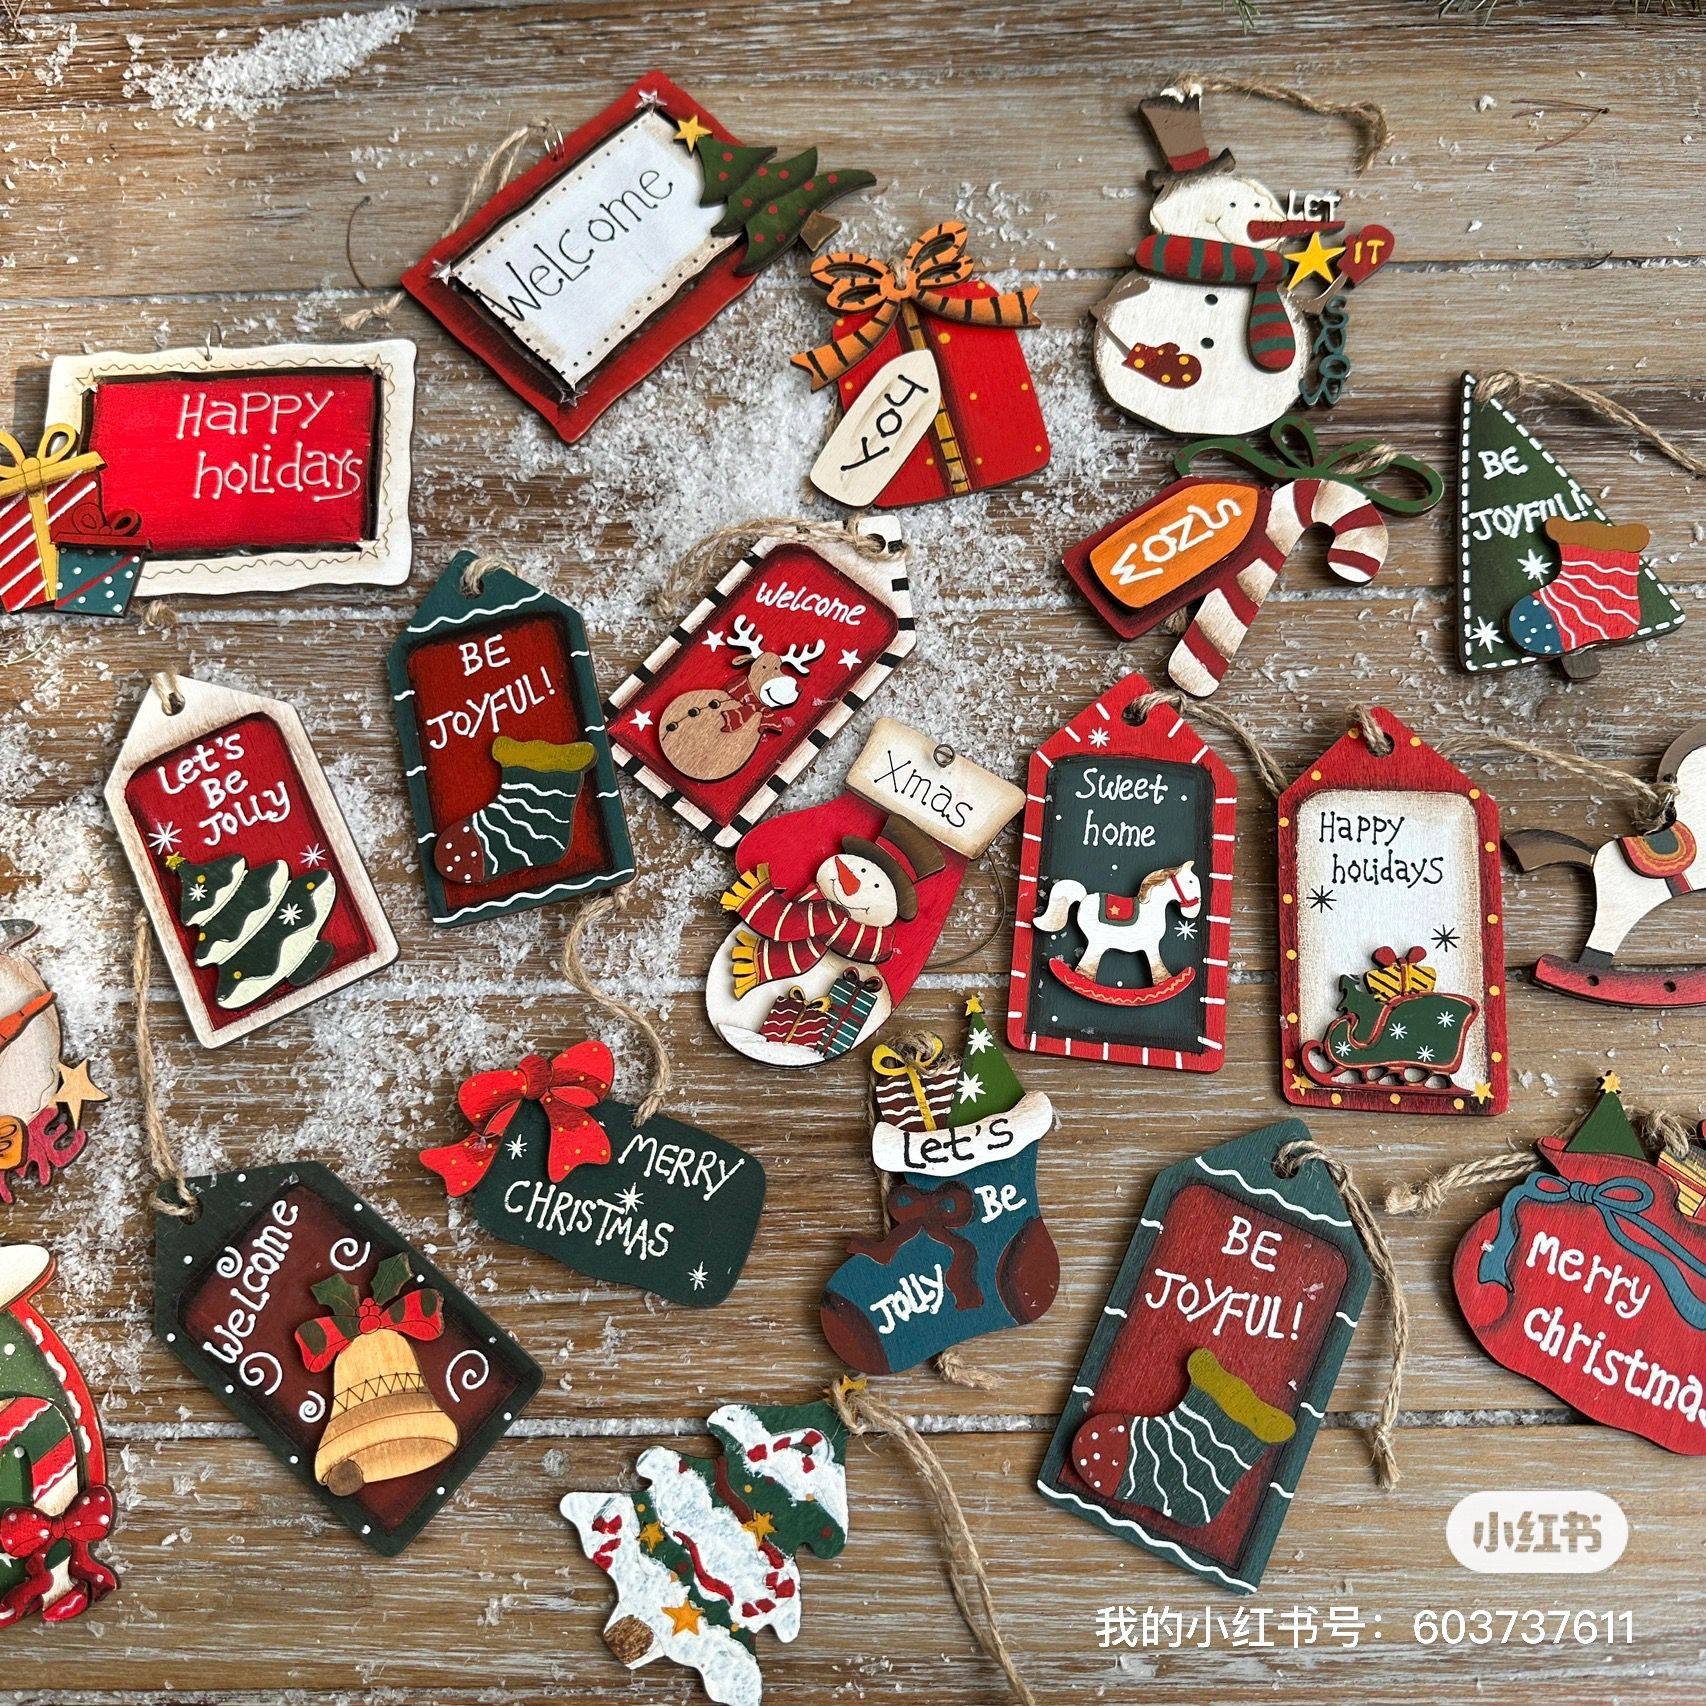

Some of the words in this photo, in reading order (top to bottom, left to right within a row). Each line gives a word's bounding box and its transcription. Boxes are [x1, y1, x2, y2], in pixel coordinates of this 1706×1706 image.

[1287, 189, 1341, 222] LET
[1354, 239, 1385, 265] IT
[1478, 446, 1529, 480] BE
[460, 635, 509, 676] BE
[426, 667, 556, 749] JOYFUL!
[157, 733, 245, 794] Let's
[206, 775, 248, 809] Be
[874, 750, 973, 828] Xmas
[1076, 768, 1168, 804] Sweet
[1083, 809, 1156, 847] home
[1332, 849, 1445, 888] holidays
[902, 1117, 1014, 1169] Let's
[618, 1133, 745, 1202] MERRY
[504, 1182, 675, 1261] CHRISTMAS
[975, 1183, 1027, 1224] Be
[1221, 1215, 1282, 1272] BE
[1145, 1268, 1303, 1340] JOYFUL!
